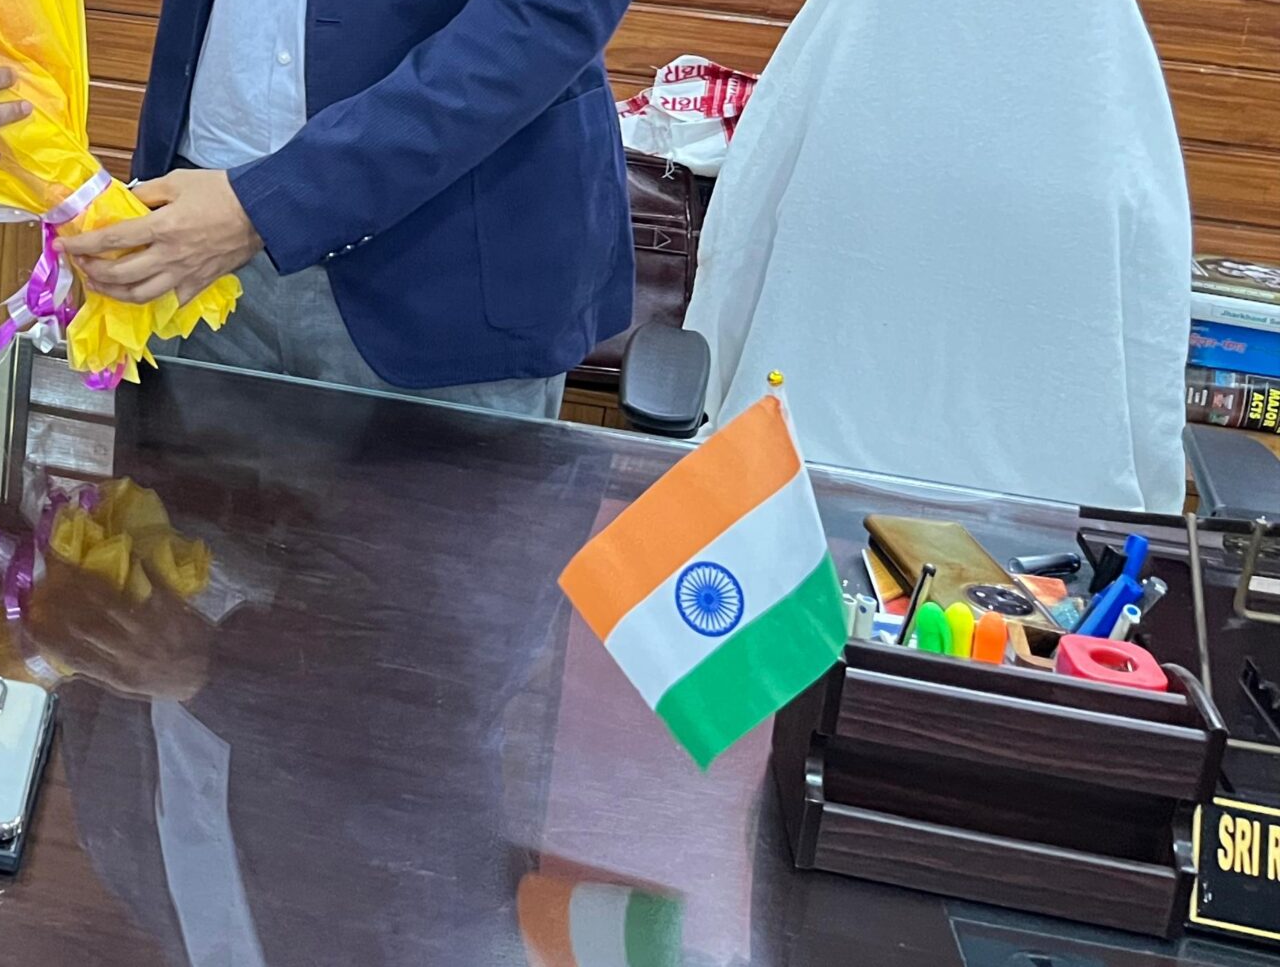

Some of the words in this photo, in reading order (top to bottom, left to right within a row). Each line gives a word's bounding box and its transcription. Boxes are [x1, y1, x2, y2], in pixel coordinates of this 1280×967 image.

[1221, 309, 1267, 323] Jharkhand
[1249, 392, 1265, 420] ACTS
[1262, 387, 1280, 427] MAJOR
[1217, 813, 1261, 877] SRI
